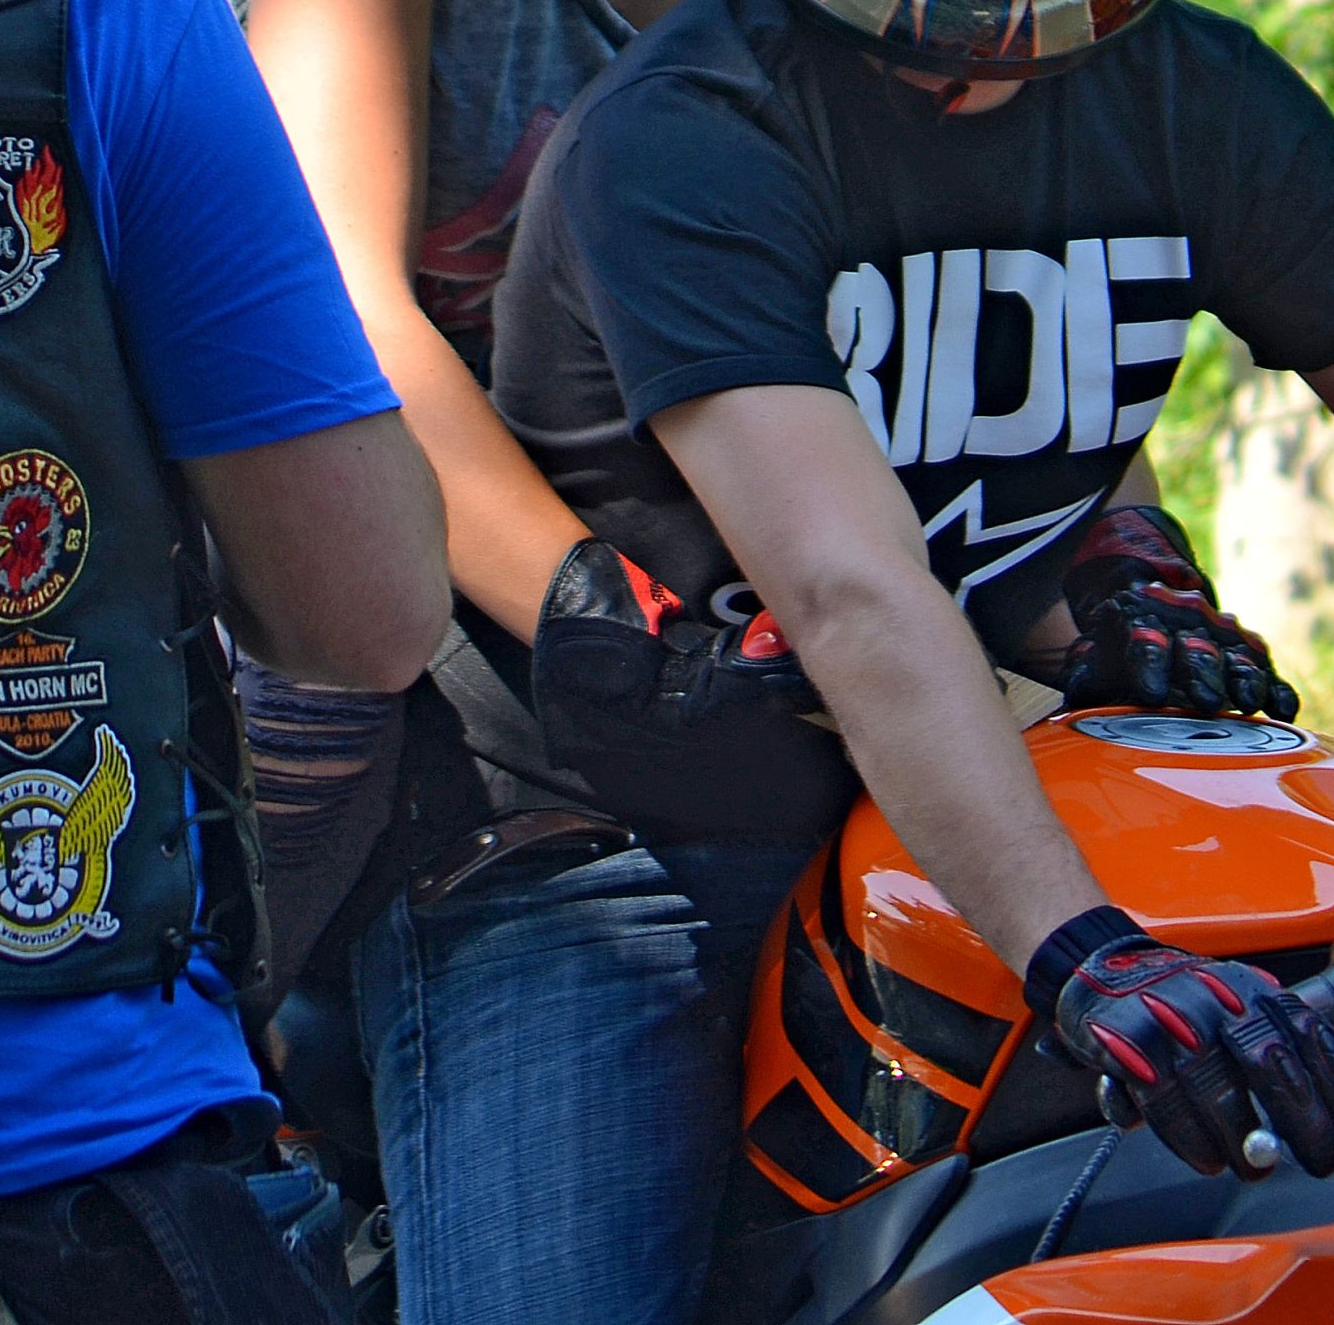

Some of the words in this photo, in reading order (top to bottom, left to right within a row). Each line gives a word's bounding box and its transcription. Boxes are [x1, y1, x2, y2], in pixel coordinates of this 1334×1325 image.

[826, 237, 1191, 468] RIDE
[28, 643, 66, 663] PARTY
[9, 676, 66, 701] HORN
[70, 672, 99, 697] MC
[26, 710, 71, 729] CROATIA
